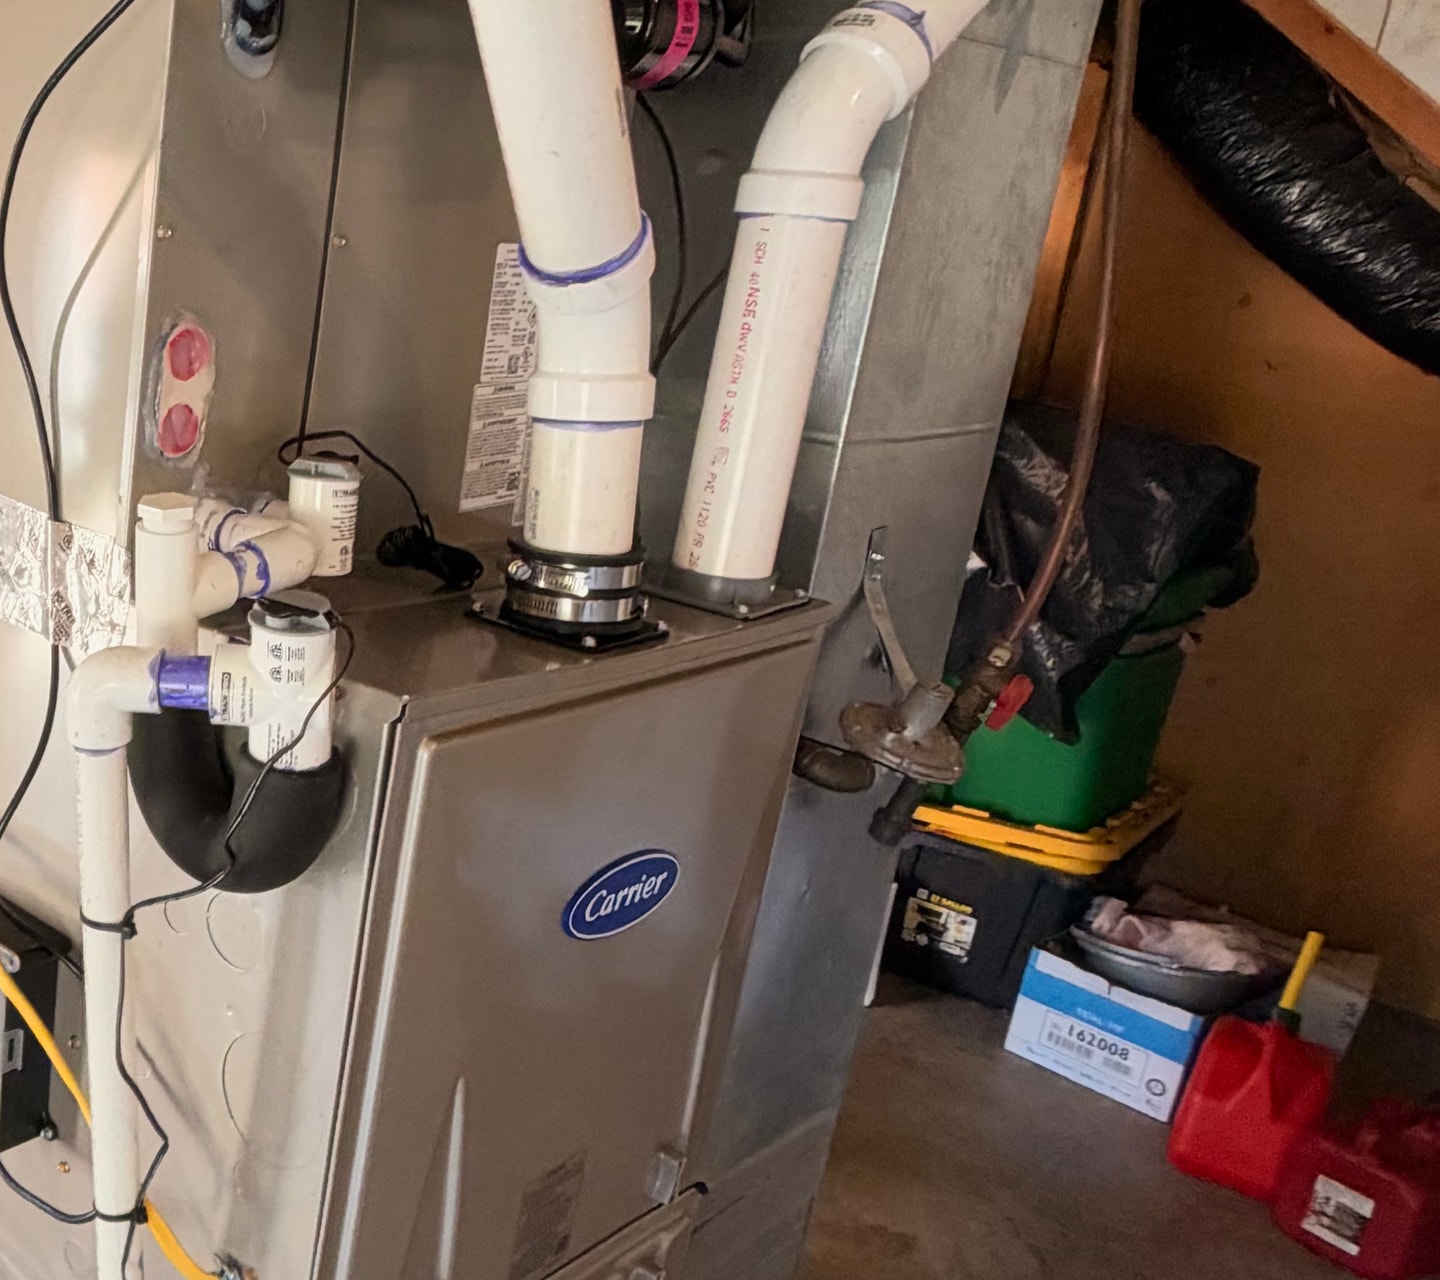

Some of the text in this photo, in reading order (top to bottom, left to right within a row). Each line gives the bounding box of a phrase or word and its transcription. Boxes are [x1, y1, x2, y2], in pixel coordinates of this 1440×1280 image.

[753, 241, 768, 265] SCH
[703, 472, 718, 494] PVC
[696, 500, 713, 528] 1120
[585, 871, 668, 922] Carrier
